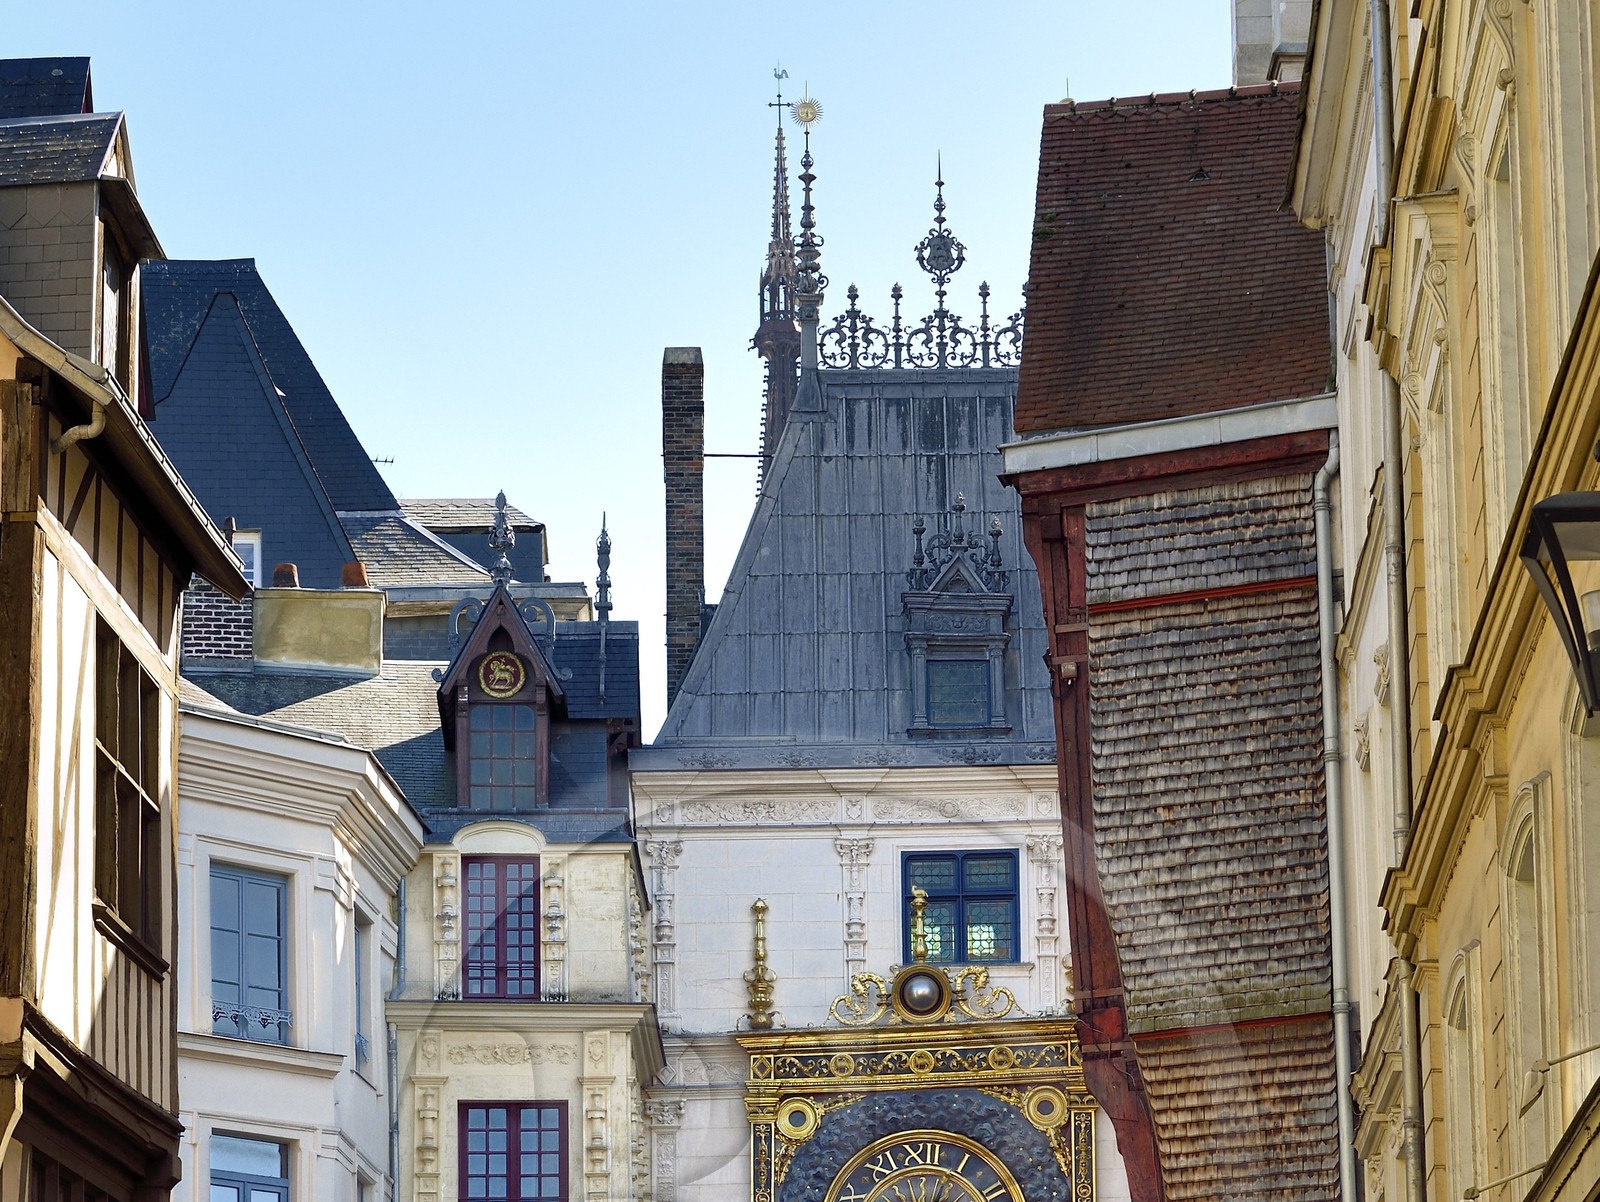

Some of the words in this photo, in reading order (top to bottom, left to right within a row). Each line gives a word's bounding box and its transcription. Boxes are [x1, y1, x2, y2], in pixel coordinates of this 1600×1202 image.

[902, 1142, 940, 1165] XII
[956, 1153, 970, 1173] I
[865, 1150, 898, 1181] XI
[983, 1180, 1006, 1201] II
